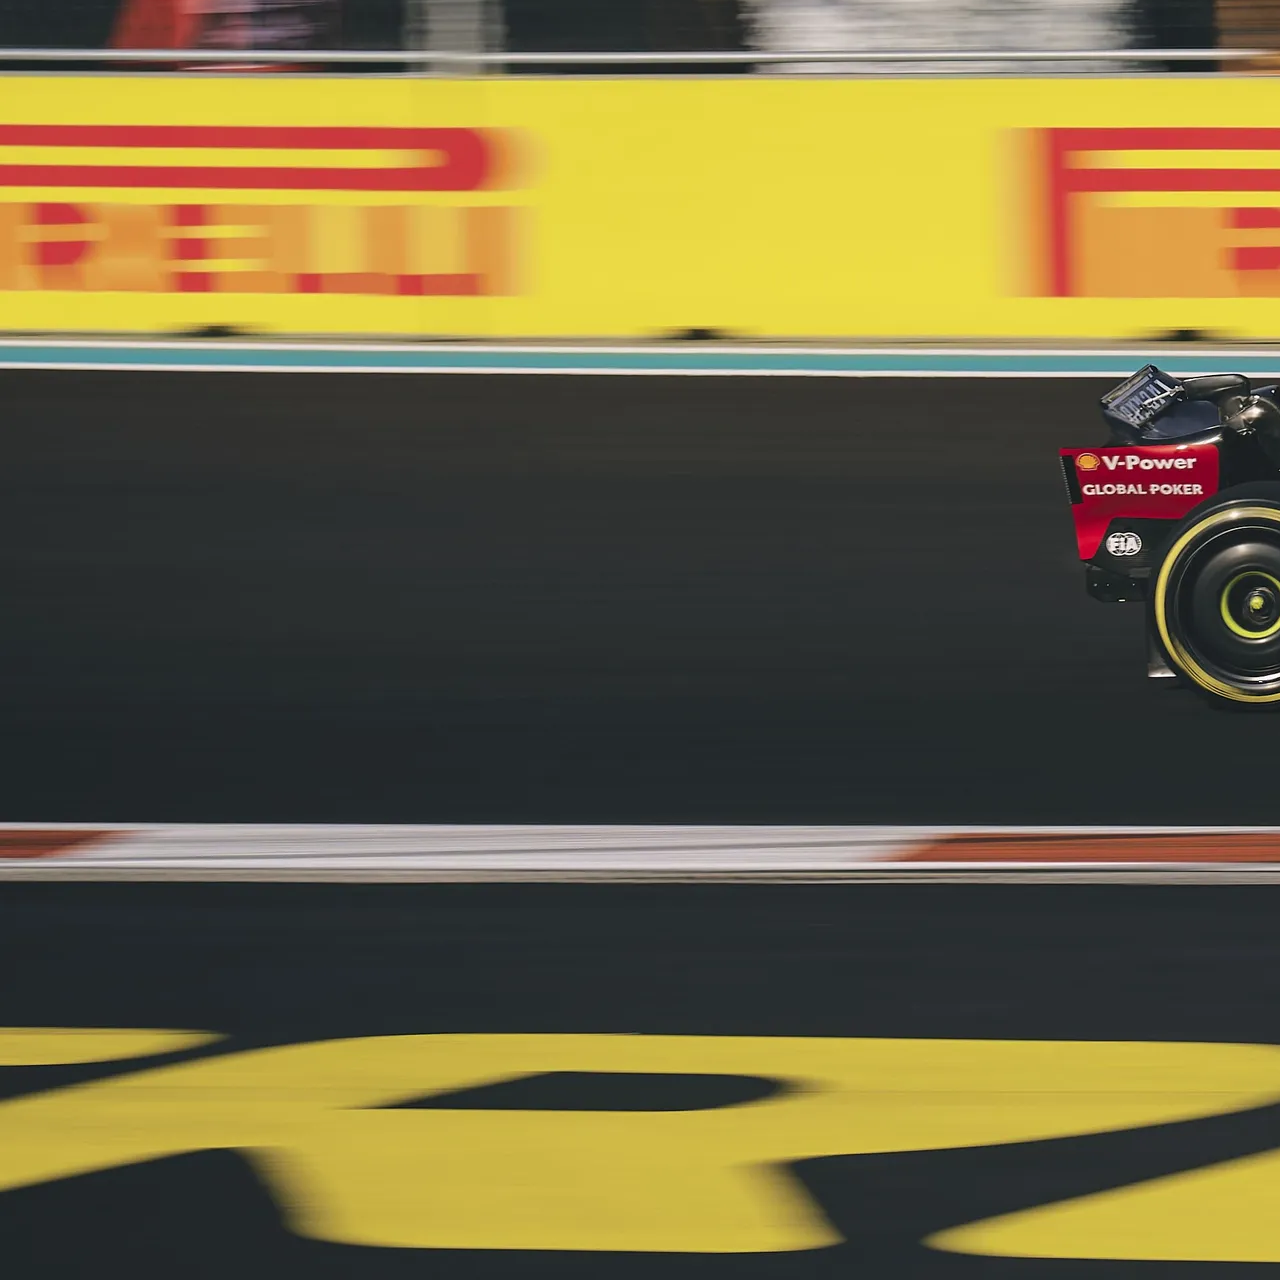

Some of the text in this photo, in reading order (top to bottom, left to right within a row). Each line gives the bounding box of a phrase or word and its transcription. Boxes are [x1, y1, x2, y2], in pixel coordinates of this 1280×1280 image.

[1101, 455, 1197, 471] V-Power
[1082, 484, 1204, 496] GLOBAL POKER
